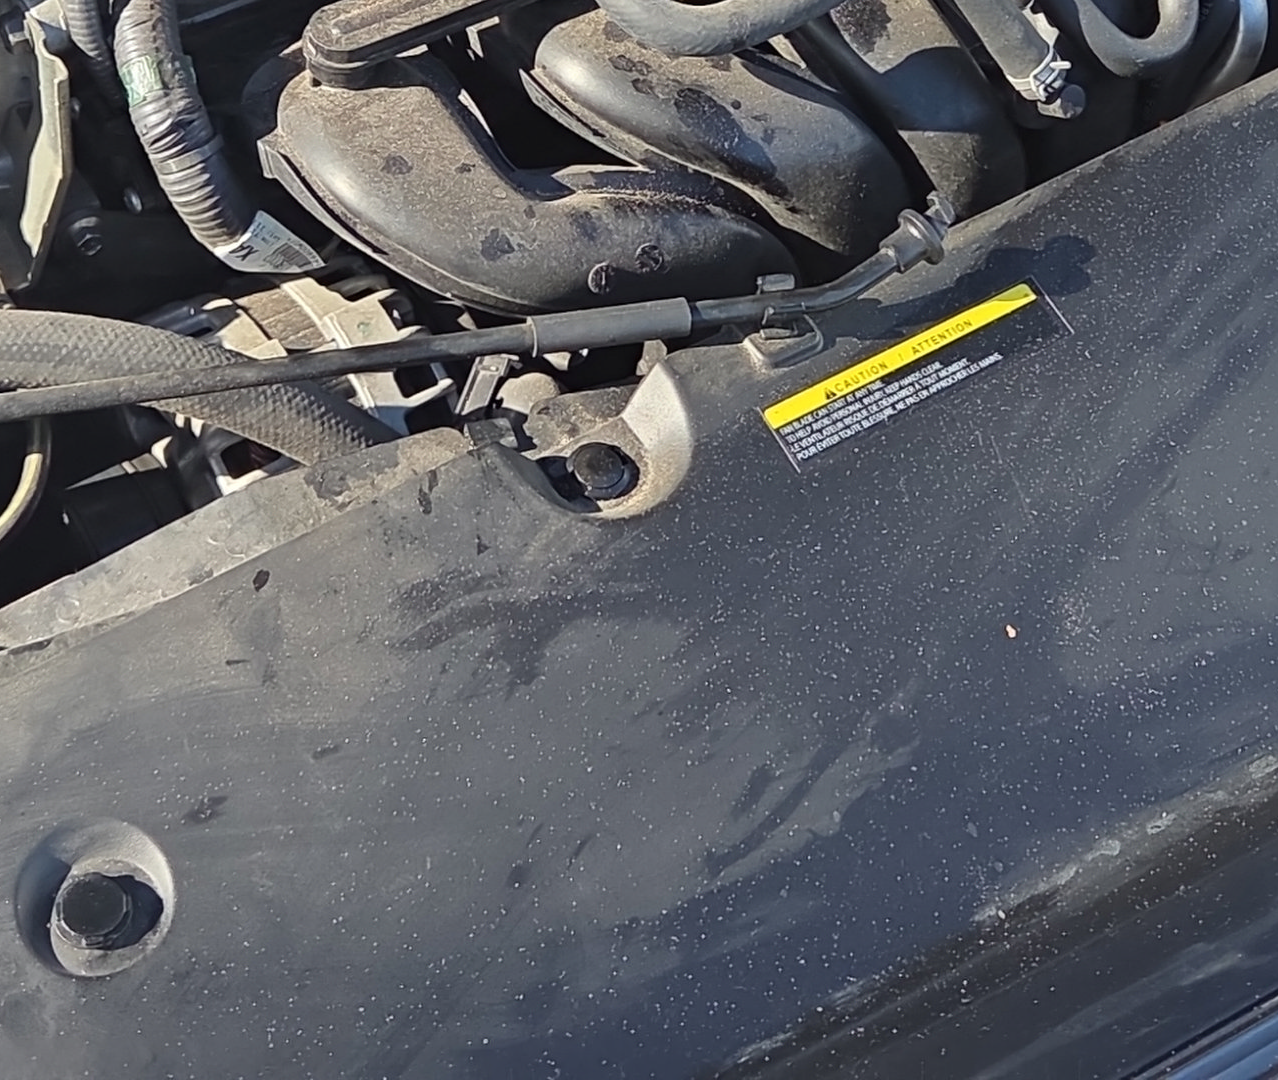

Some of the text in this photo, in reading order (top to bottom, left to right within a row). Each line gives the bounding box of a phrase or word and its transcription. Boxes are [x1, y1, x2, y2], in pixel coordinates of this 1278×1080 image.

[833, 359, 888, 393] CAUTION
[910, 317, 973, 355] ATTENTION
[778, 423, 794, 436] FAN
[792, 412, 816, 430] BLADE
[813, 406, 829, 419] CAN
[826, 396, 847, 413] START
[845, 392, 855, 403] AT
[853, 386, 868, 399] ANY
[785, 433, 797, 444] TO
[794, 425, 813, 439] HELP
[810, 415, 833, 431] AVOID
[830, 399, 864, 421] PERSONAL
[883, 381, 901, 394] KEEP
[898, 370, 922, 387] HANDS
[795, 445, 818, 461] POUR
[815, 432, 841, 451] ÉVITER
[838, 422, 863, 439] TOUTE
[894, 399, 906, 411] NE
[904, 393, 920, 405] PAS
[917, 388, 930, 399] EN
[927, 368, 969, 394] APPROCHER
[966, 362, 980, 374] LES
[800, 419, 845, 448] VENTILATEUR
[843, 407, 870, 426] RISQUE
[878, 383, 916, 408] DÉMARRER
[918, 372, 939, 388] TOUT
